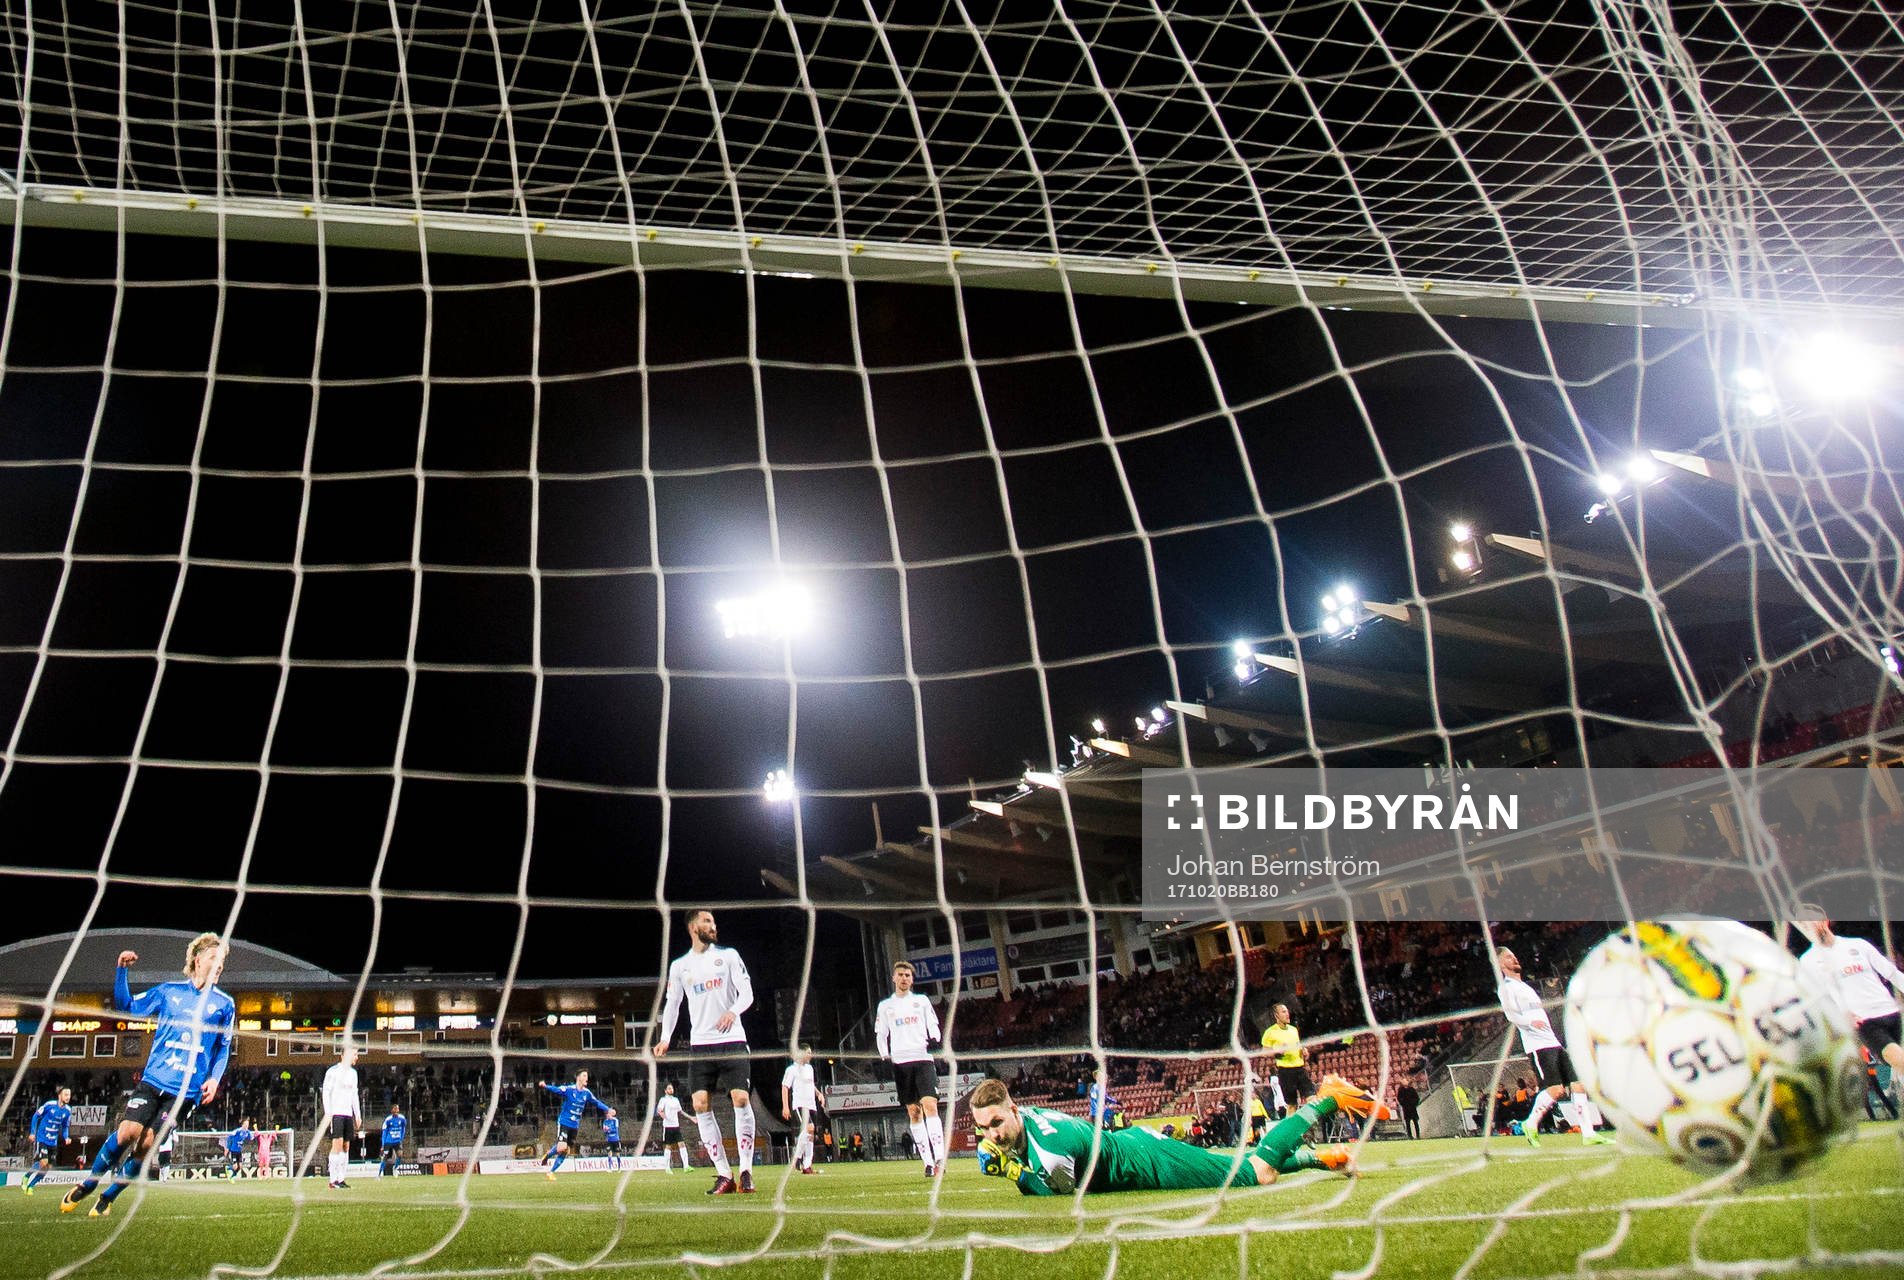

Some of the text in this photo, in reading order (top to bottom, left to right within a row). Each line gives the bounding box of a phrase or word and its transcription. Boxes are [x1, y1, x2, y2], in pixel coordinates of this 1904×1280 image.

[693, 977, 724, 995] ELON
[52, 1019, 101, 1034] SHARP
[1668, 1038, 1747, 1083] SEL
